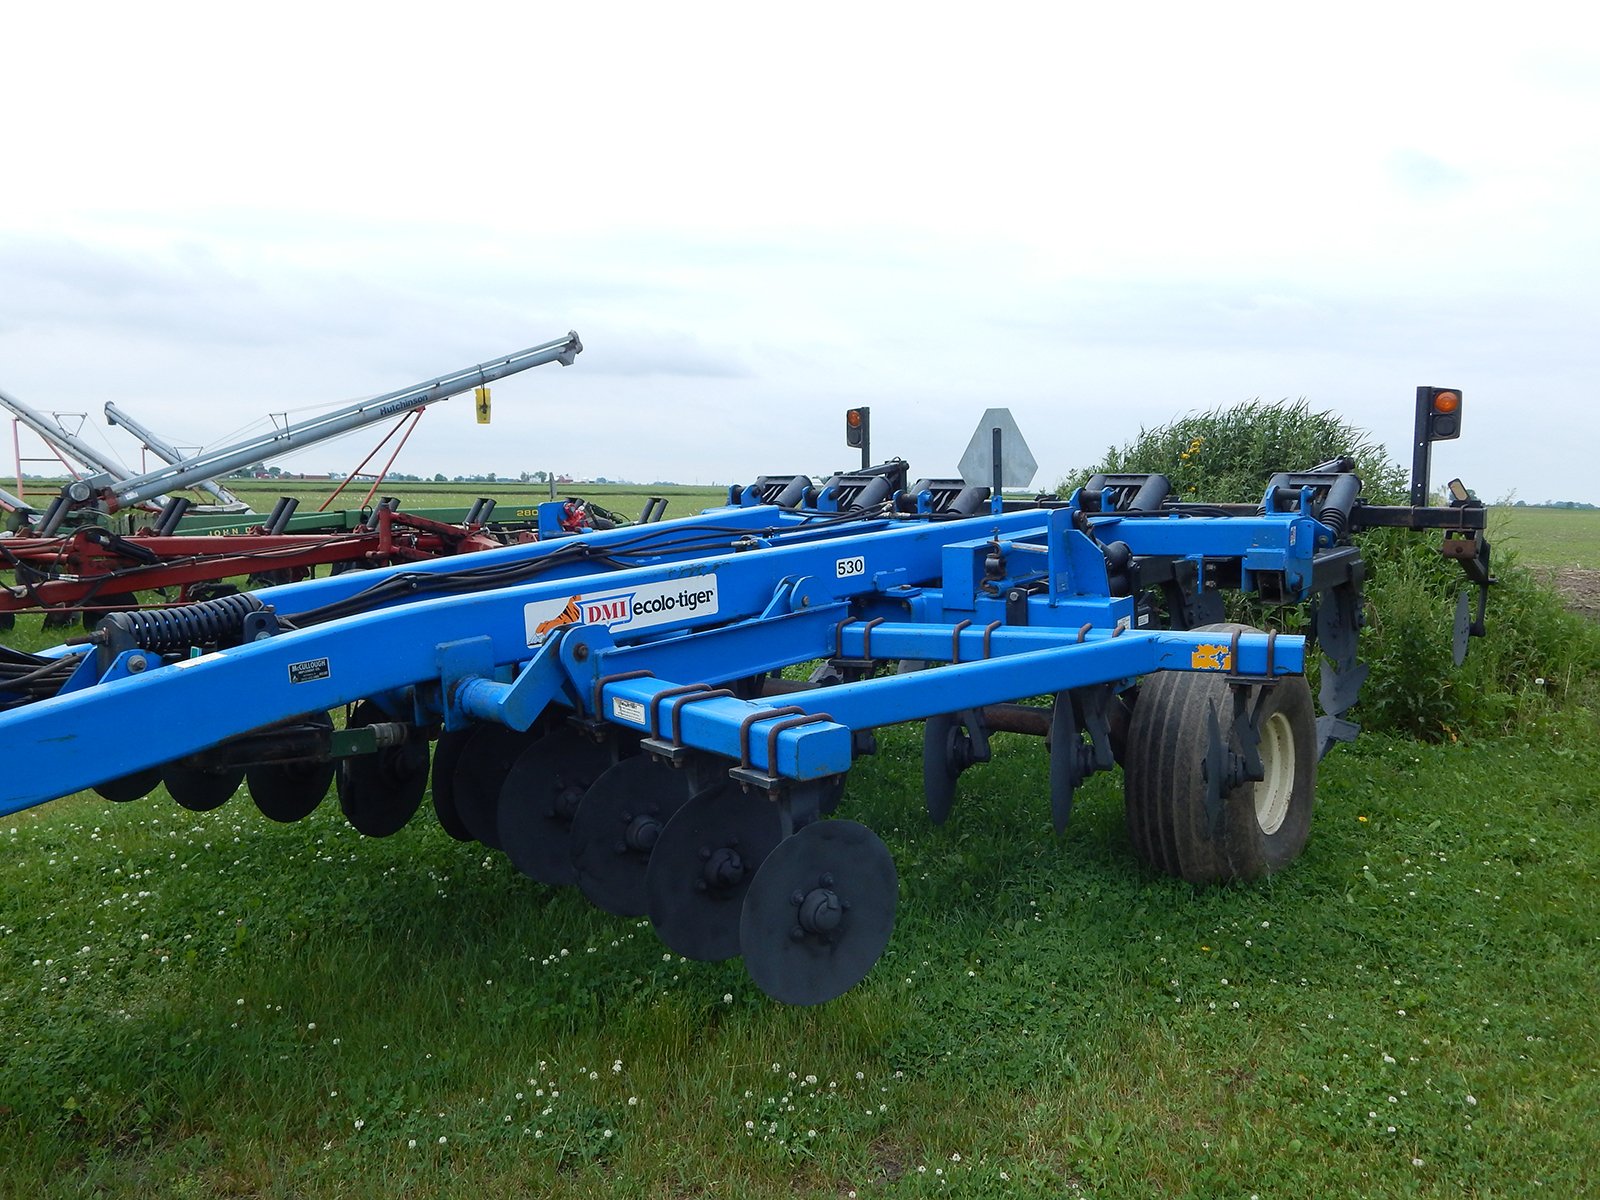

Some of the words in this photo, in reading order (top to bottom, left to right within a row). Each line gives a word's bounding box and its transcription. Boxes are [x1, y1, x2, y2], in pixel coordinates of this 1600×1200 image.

[380, 395, 428, 415] Hutchinson
[207, 528, 239, 537] JOHN
[838, 559, 863, 575] 530
[588, 601, 627, 623] DMI
[633, 589, 714, 616] ecolo-tiger
